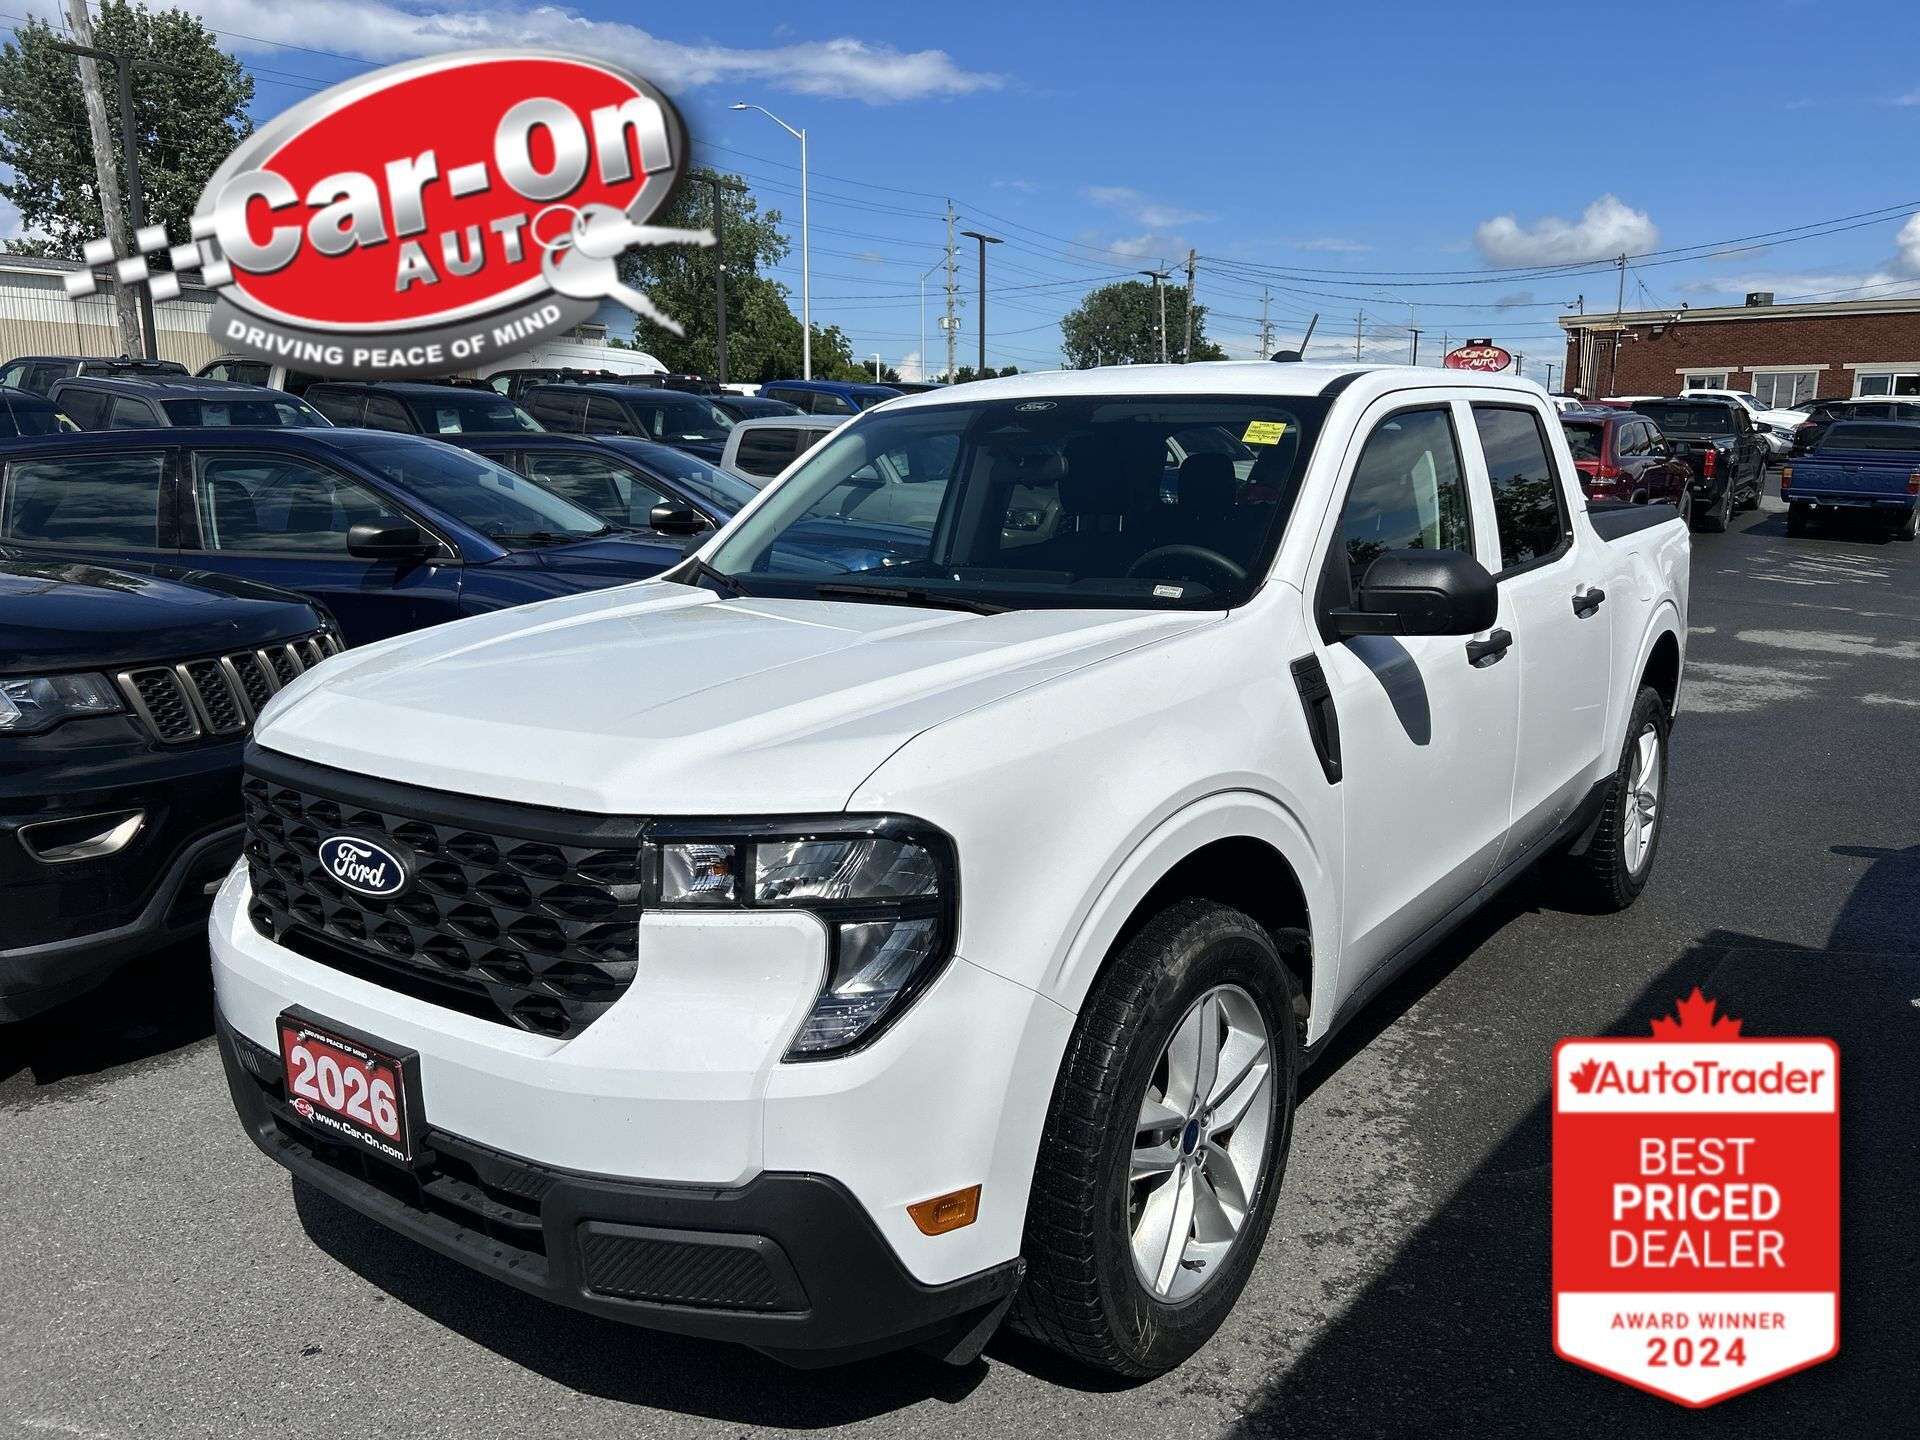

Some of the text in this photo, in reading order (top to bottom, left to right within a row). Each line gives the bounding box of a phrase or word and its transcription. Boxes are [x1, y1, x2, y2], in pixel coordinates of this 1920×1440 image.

[1463, 349, 1499, 358] Car-On
[334, 842, 385, 887] Ford
[291, 1045, 398, 1136] 2026
[315, 1112, 405, 1162] www.Car-On.com
